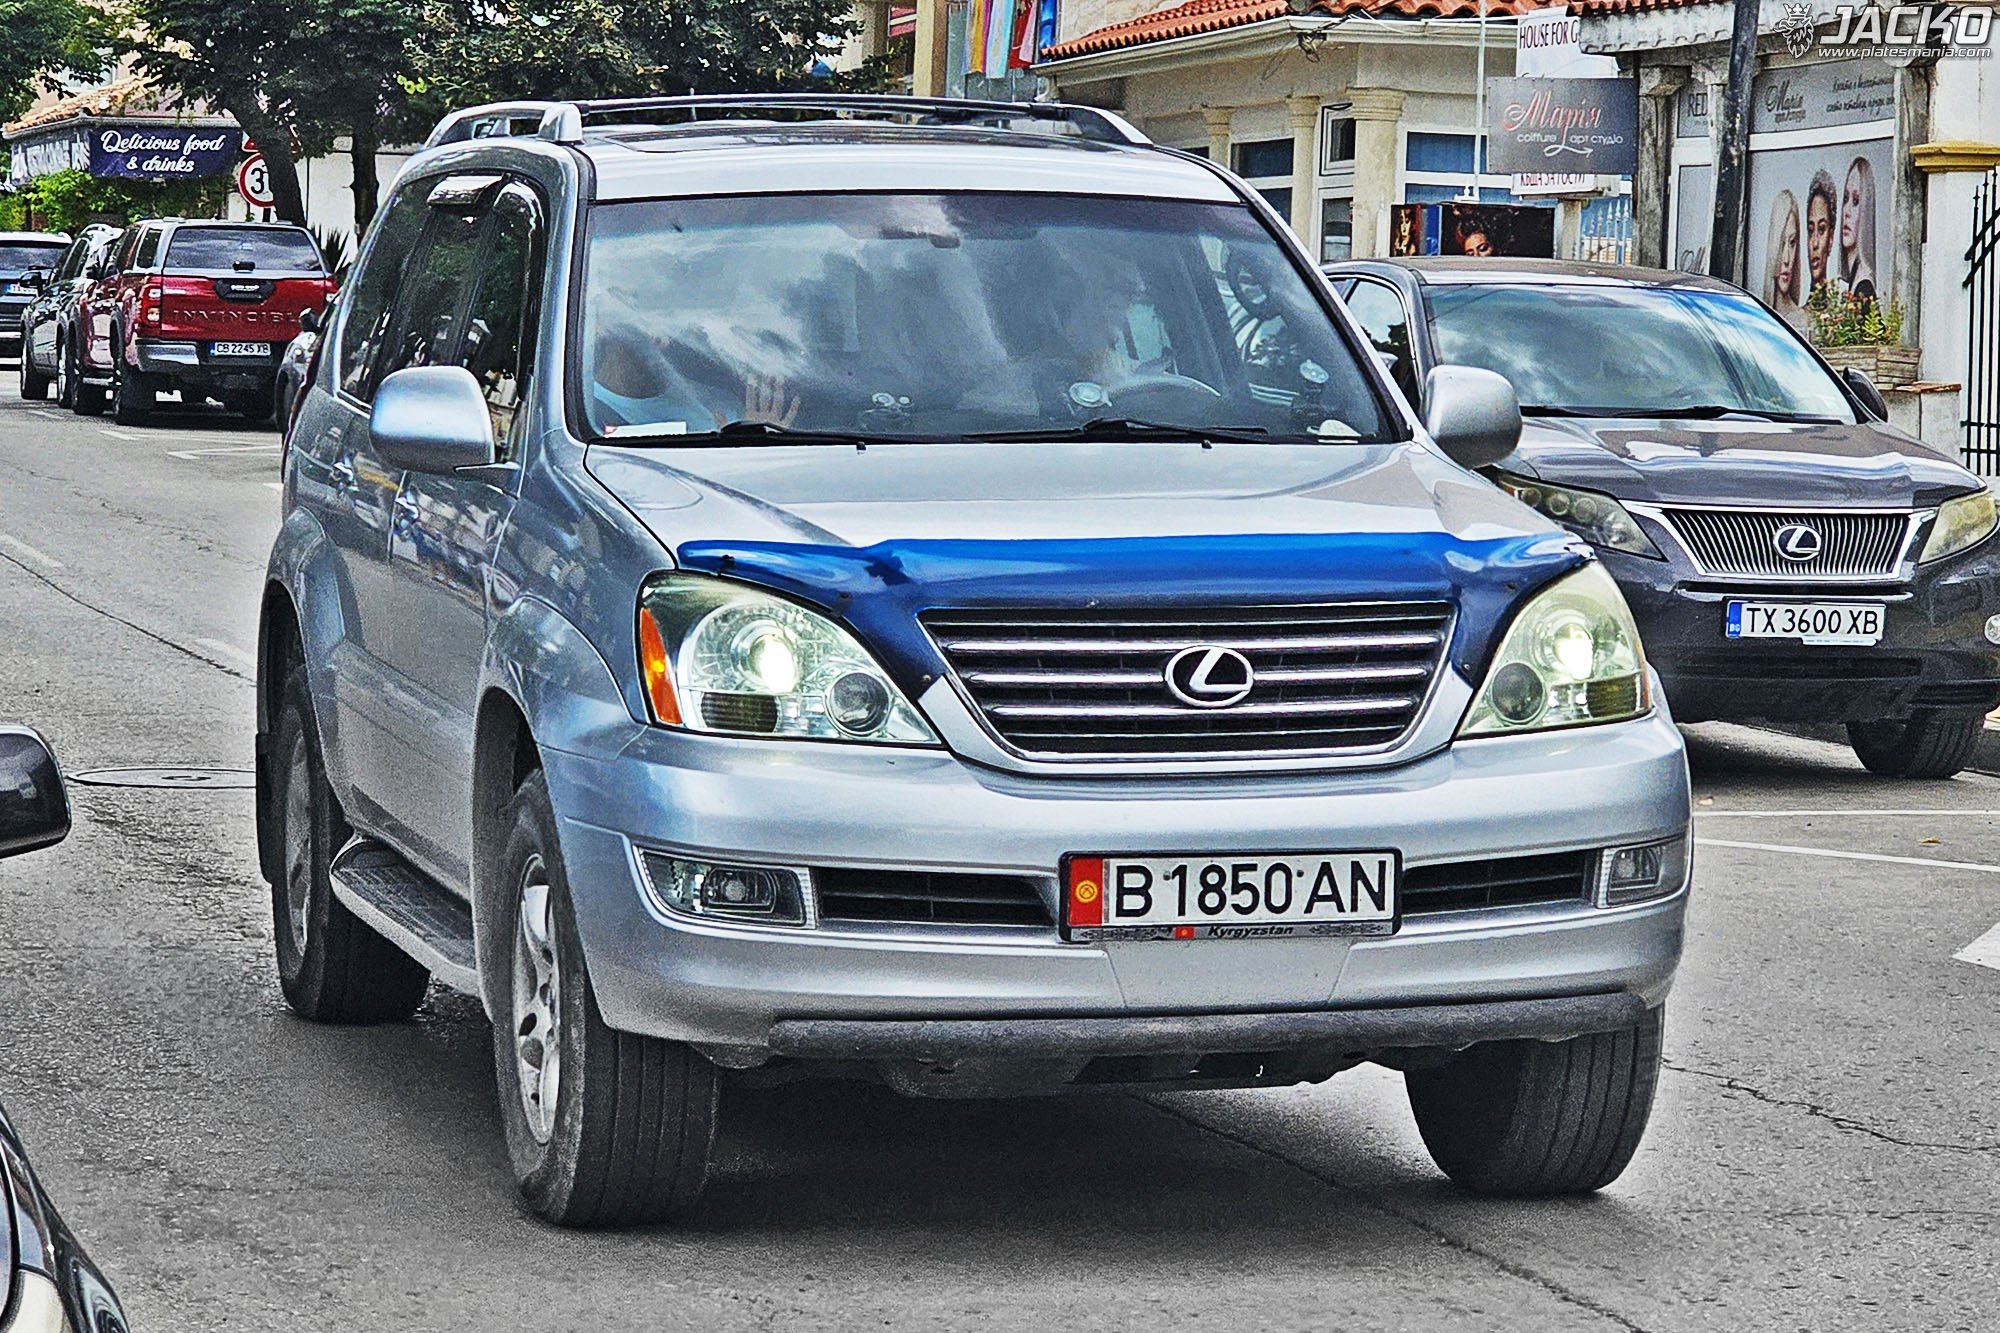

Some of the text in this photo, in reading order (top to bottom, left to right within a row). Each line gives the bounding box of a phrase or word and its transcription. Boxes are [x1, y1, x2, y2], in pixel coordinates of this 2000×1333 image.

[1519, 23, 1549, 49] HOUSE
[1550, 21, 1569, 46] FOR
[100, 129, 225, 155] Delicious food
[126, 156, 195, 172] & drinks
[173, 310, 300, 322] INVINCIBL
[1207, 925, 1294, 938] Kyrgyzstan
